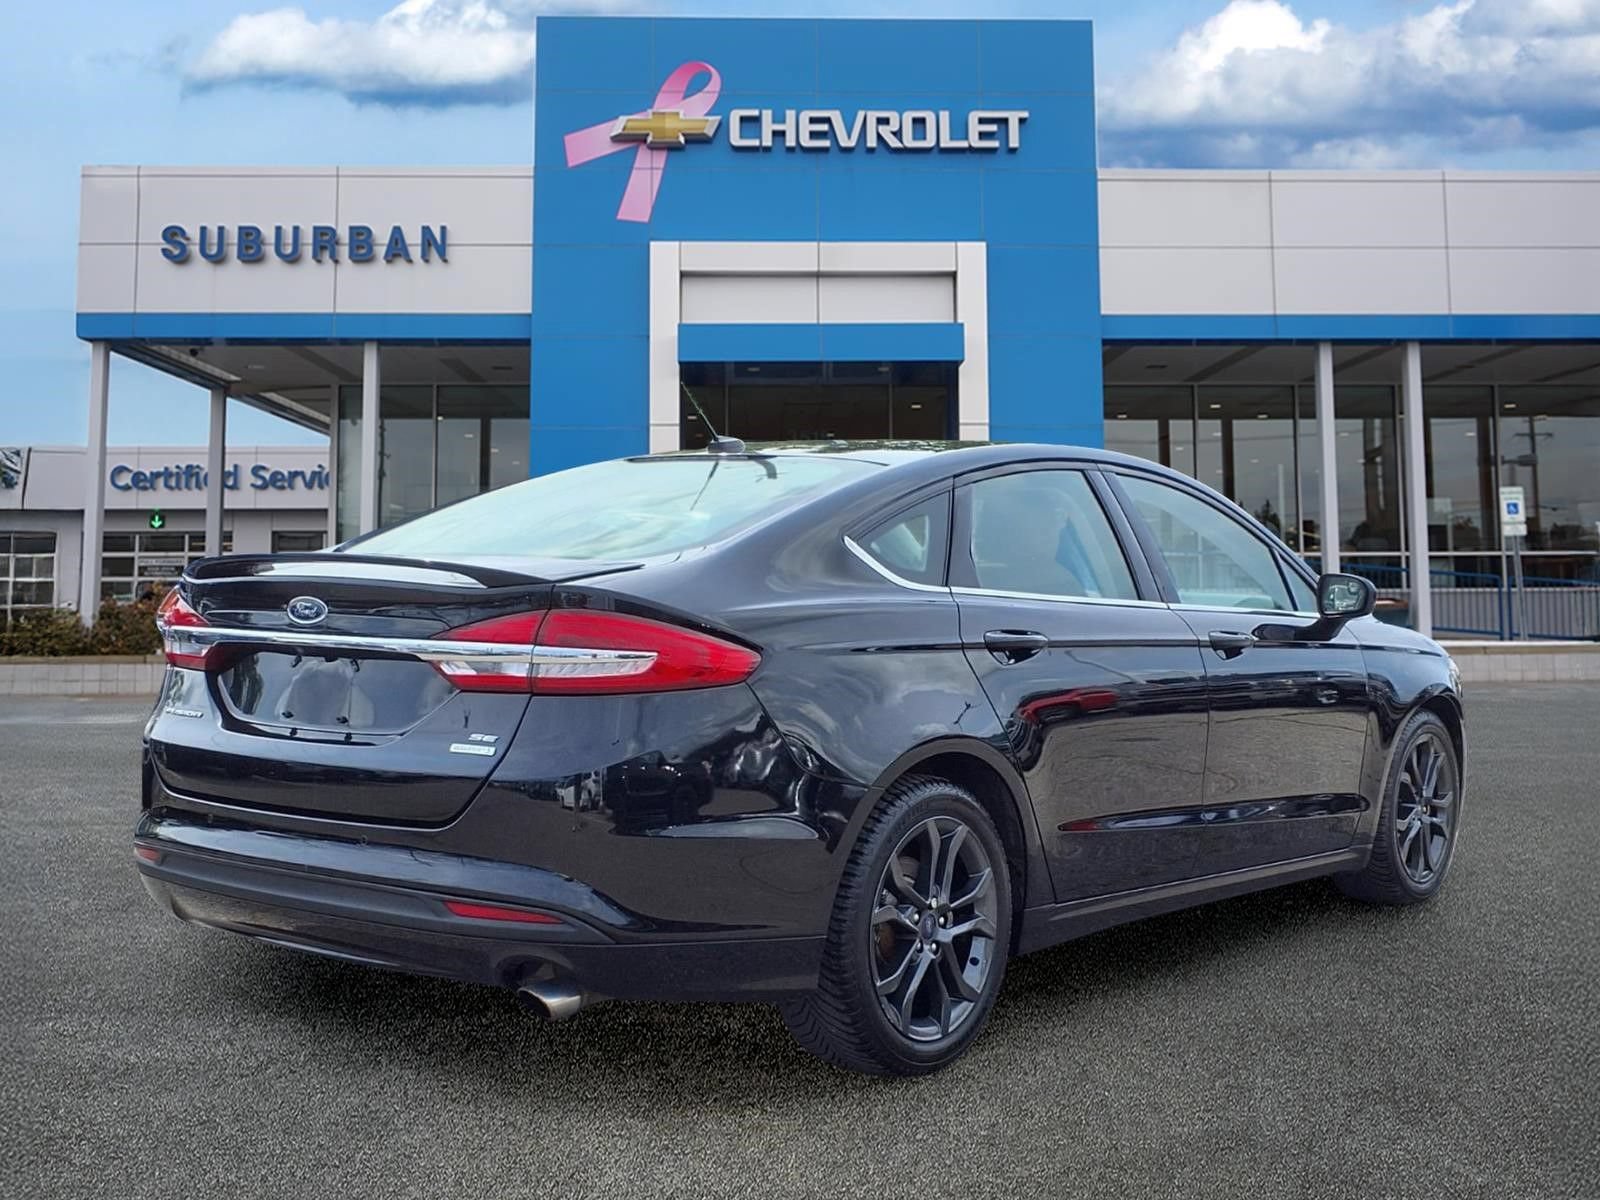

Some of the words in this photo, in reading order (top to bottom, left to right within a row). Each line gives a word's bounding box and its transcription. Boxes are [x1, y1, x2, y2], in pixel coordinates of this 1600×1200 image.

[729, 109, 1029, 149] CHEVROLET
[161, 225, 448, 263] SUBURBAN
[110, 464, 239, 491] Certifid
[468, 733, 498, 743] SE
